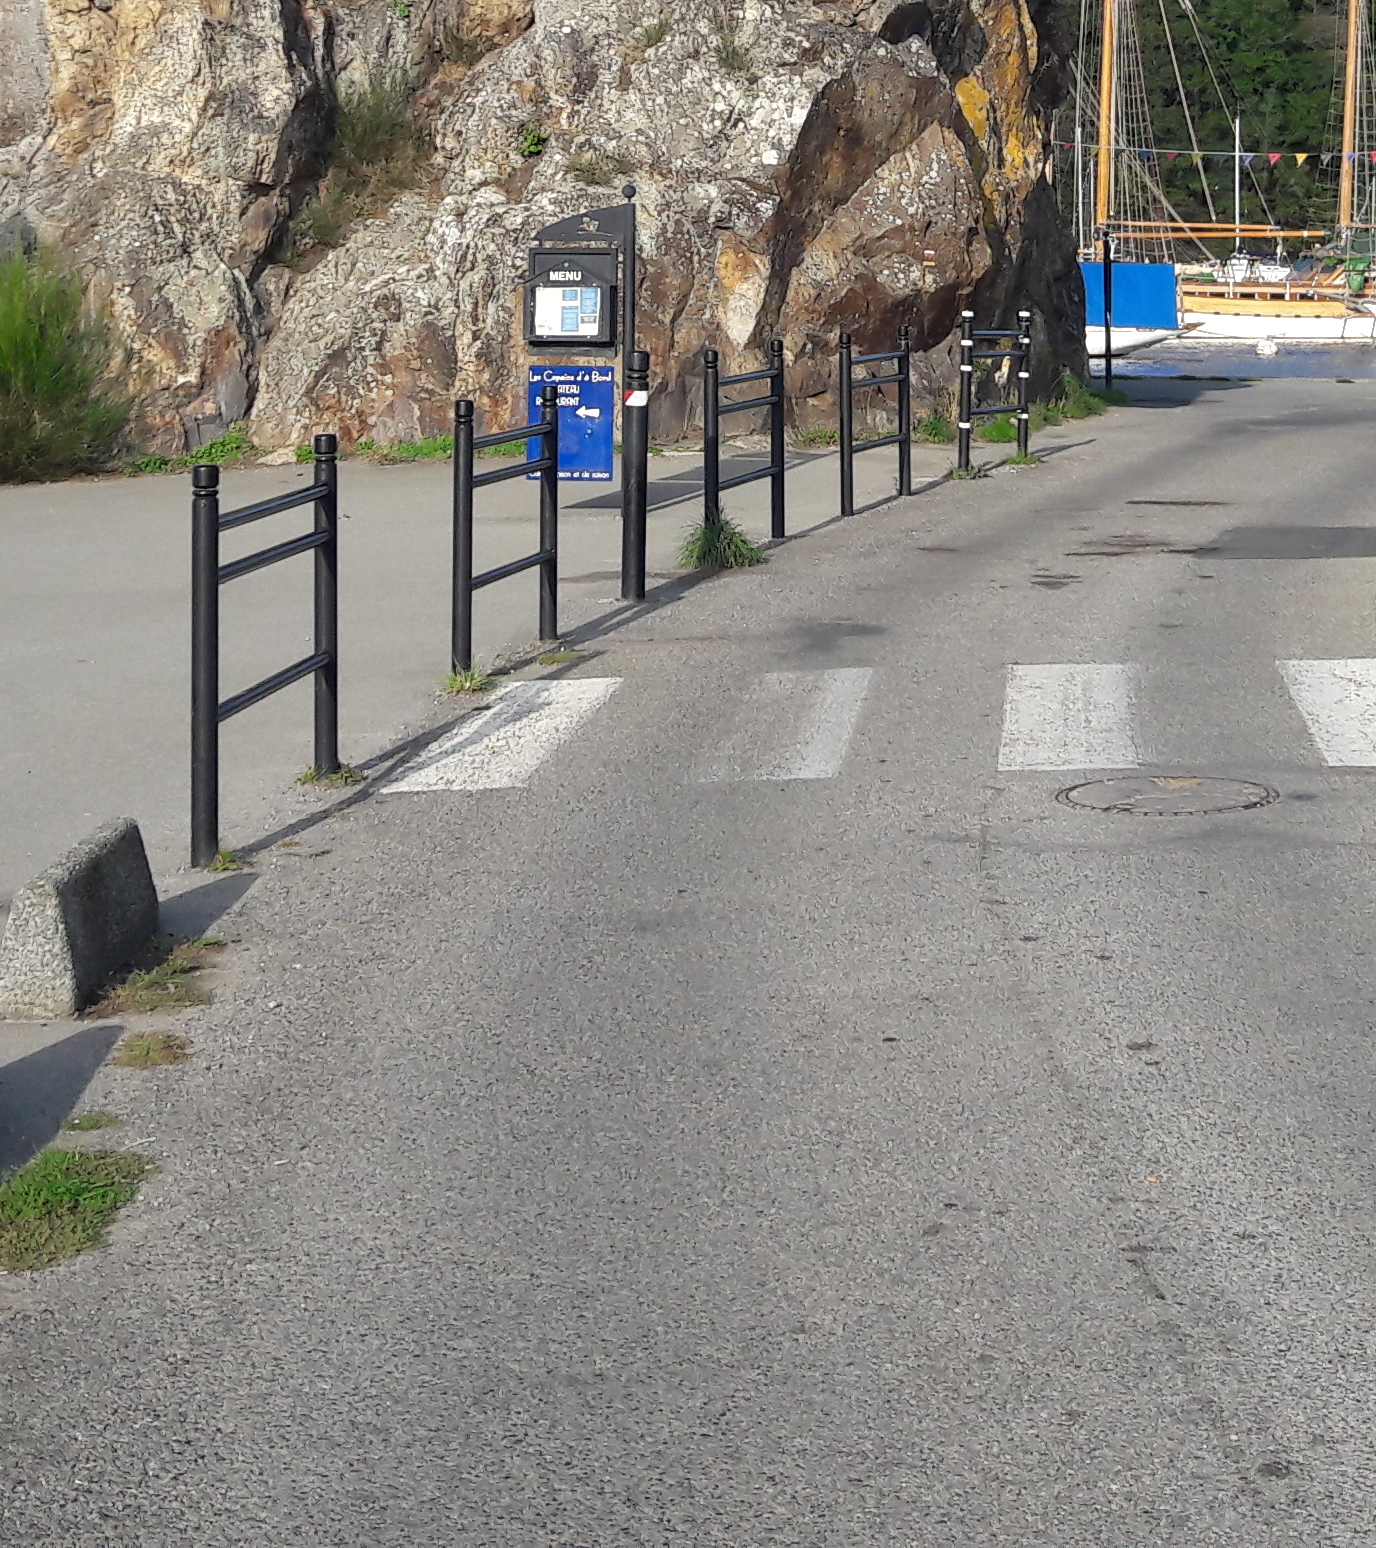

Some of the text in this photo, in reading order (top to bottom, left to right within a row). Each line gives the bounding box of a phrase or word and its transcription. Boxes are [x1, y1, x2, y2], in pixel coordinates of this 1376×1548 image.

[549, 270, 582, 281] MENU
[529, 370, 541, 382] Les
[591, 370, 611, 382] Bord
[557, 384, 580, 394] ATEAU
